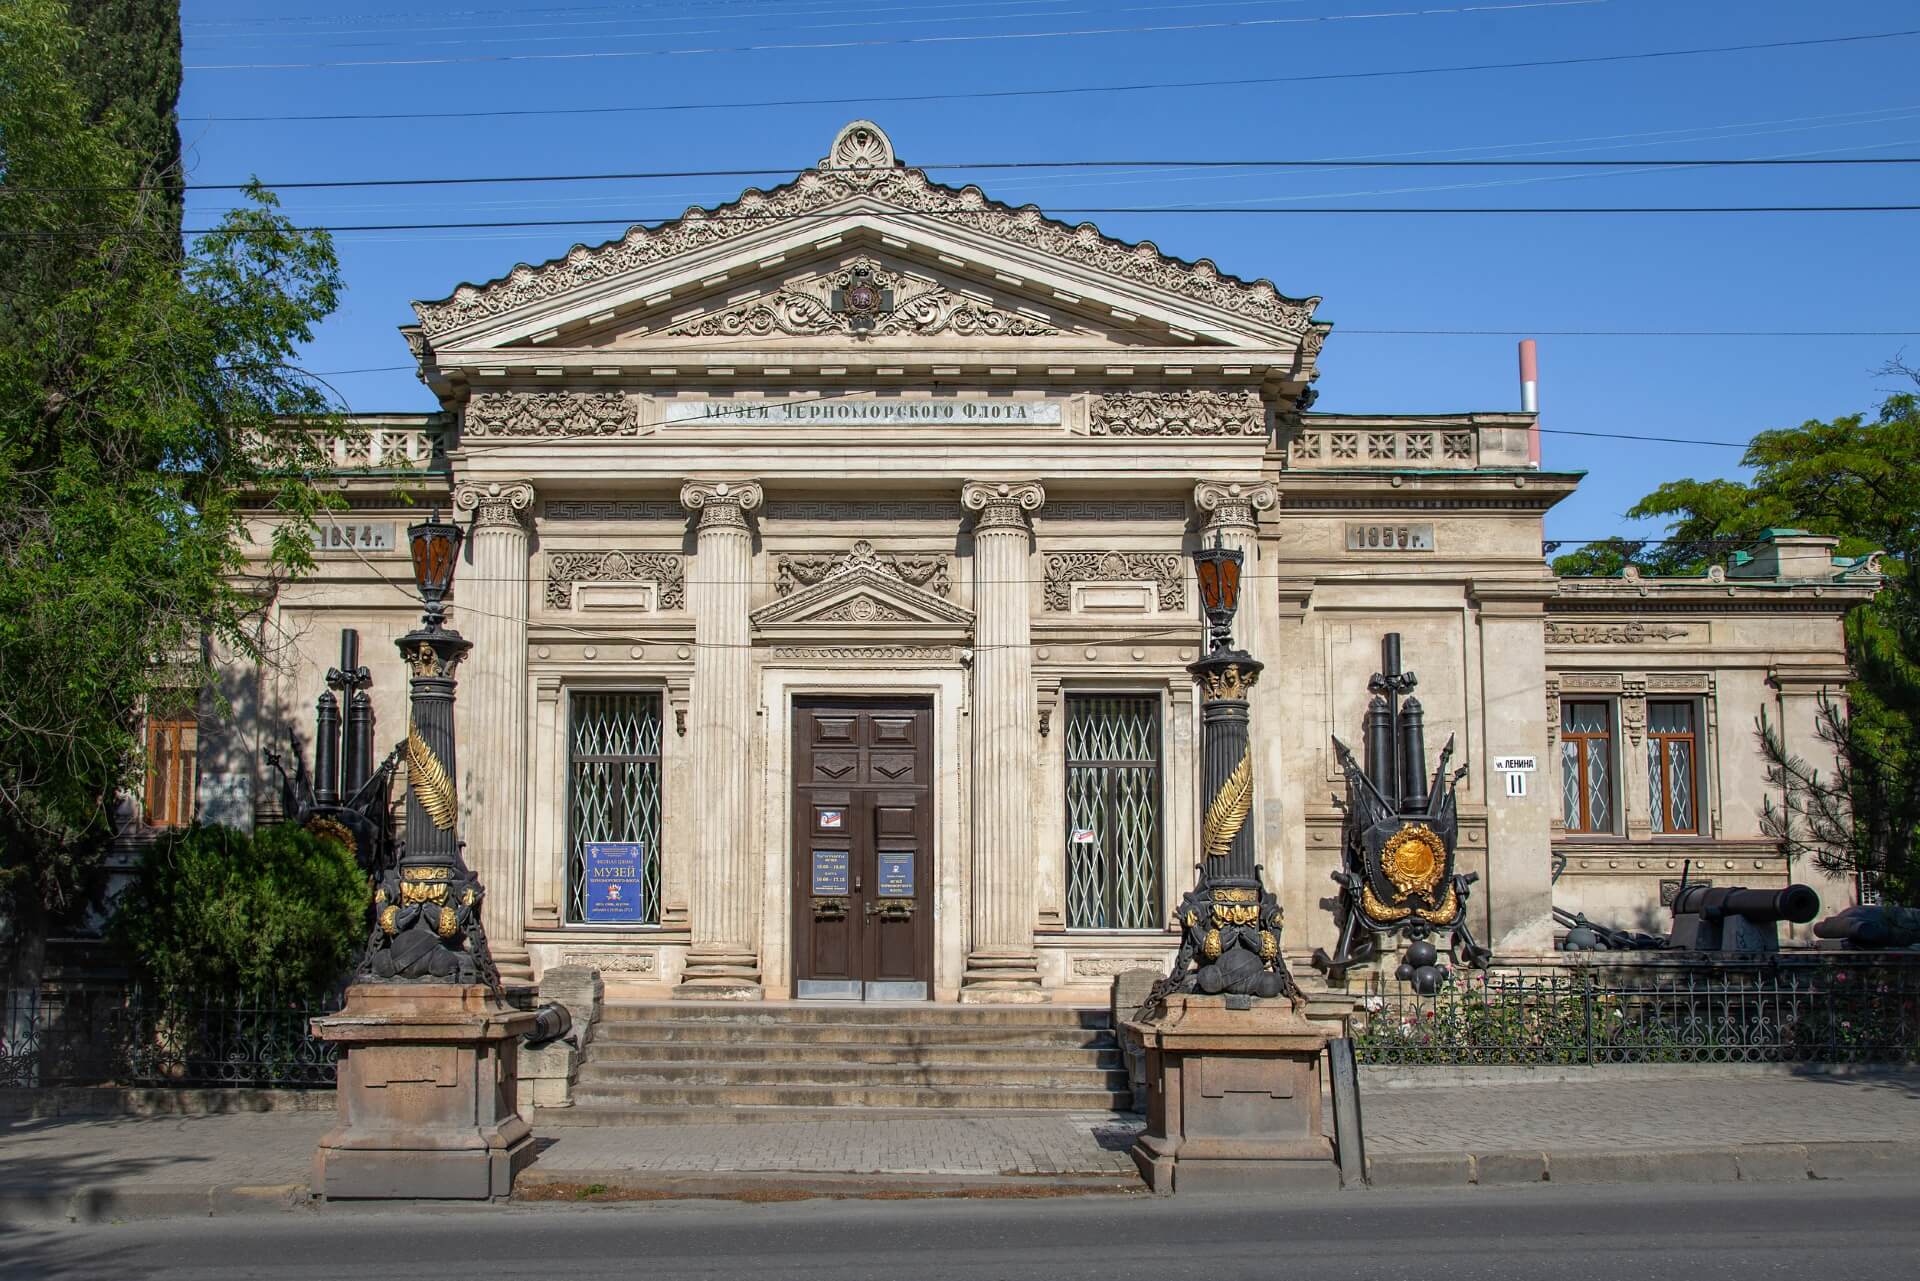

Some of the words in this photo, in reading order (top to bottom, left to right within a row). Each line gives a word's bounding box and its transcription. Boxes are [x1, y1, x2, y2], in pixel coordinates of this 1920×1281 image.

[782, 403, 954, 421] ЧЕРНОМОРСКОГО
[962, 403, 1028, 419] ФЛОТА
[1505, 759, 1534, 769] ЛЕНИНА
[1510, 774, 1522, 794] 11
[593, 865, 636, 878] МУЗЕЙ
